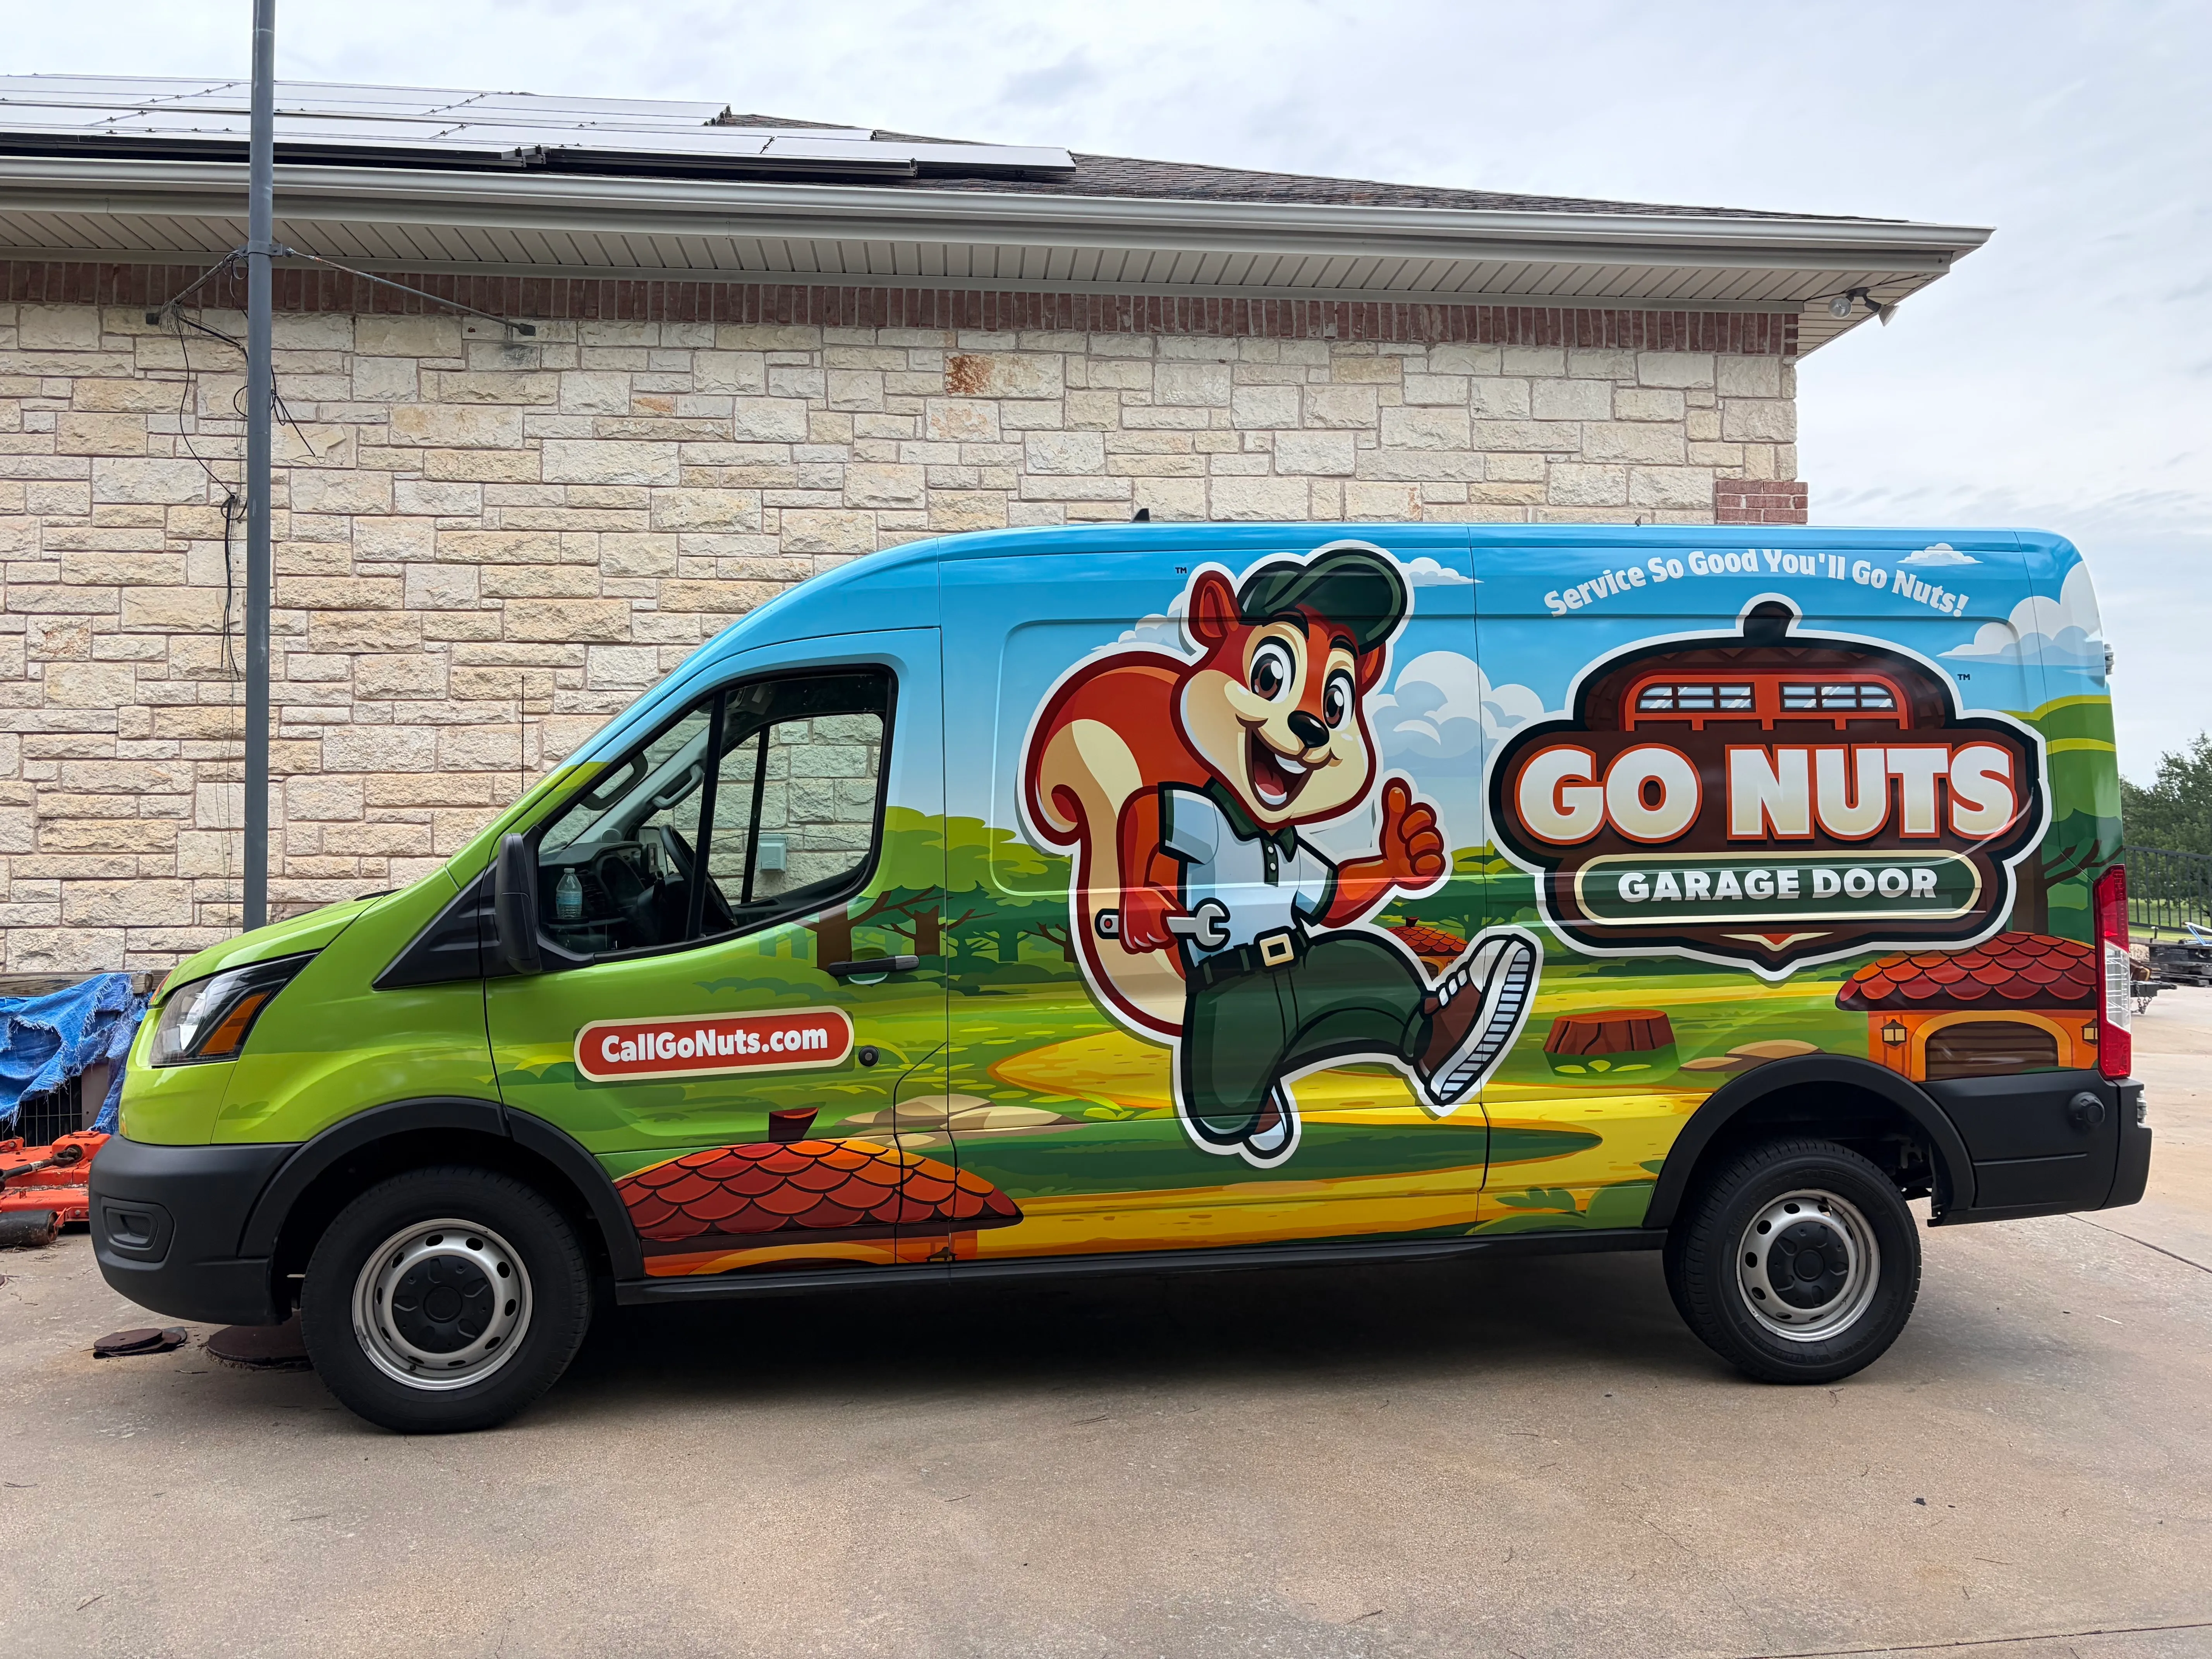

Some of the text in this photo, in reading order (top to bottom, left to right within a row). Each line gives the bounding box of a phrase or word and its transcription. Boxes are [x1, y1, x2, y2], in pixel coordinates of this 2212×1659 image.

[1544, 549, 1970, 618] Service So Good You'll Go Nuts!
[1514, 741, 2018, 843] GO NUTS
[1618, 867, 1938, 902] GARAGE DOOR
[601, 1027, 828, 1063] CallGoNuts.com
